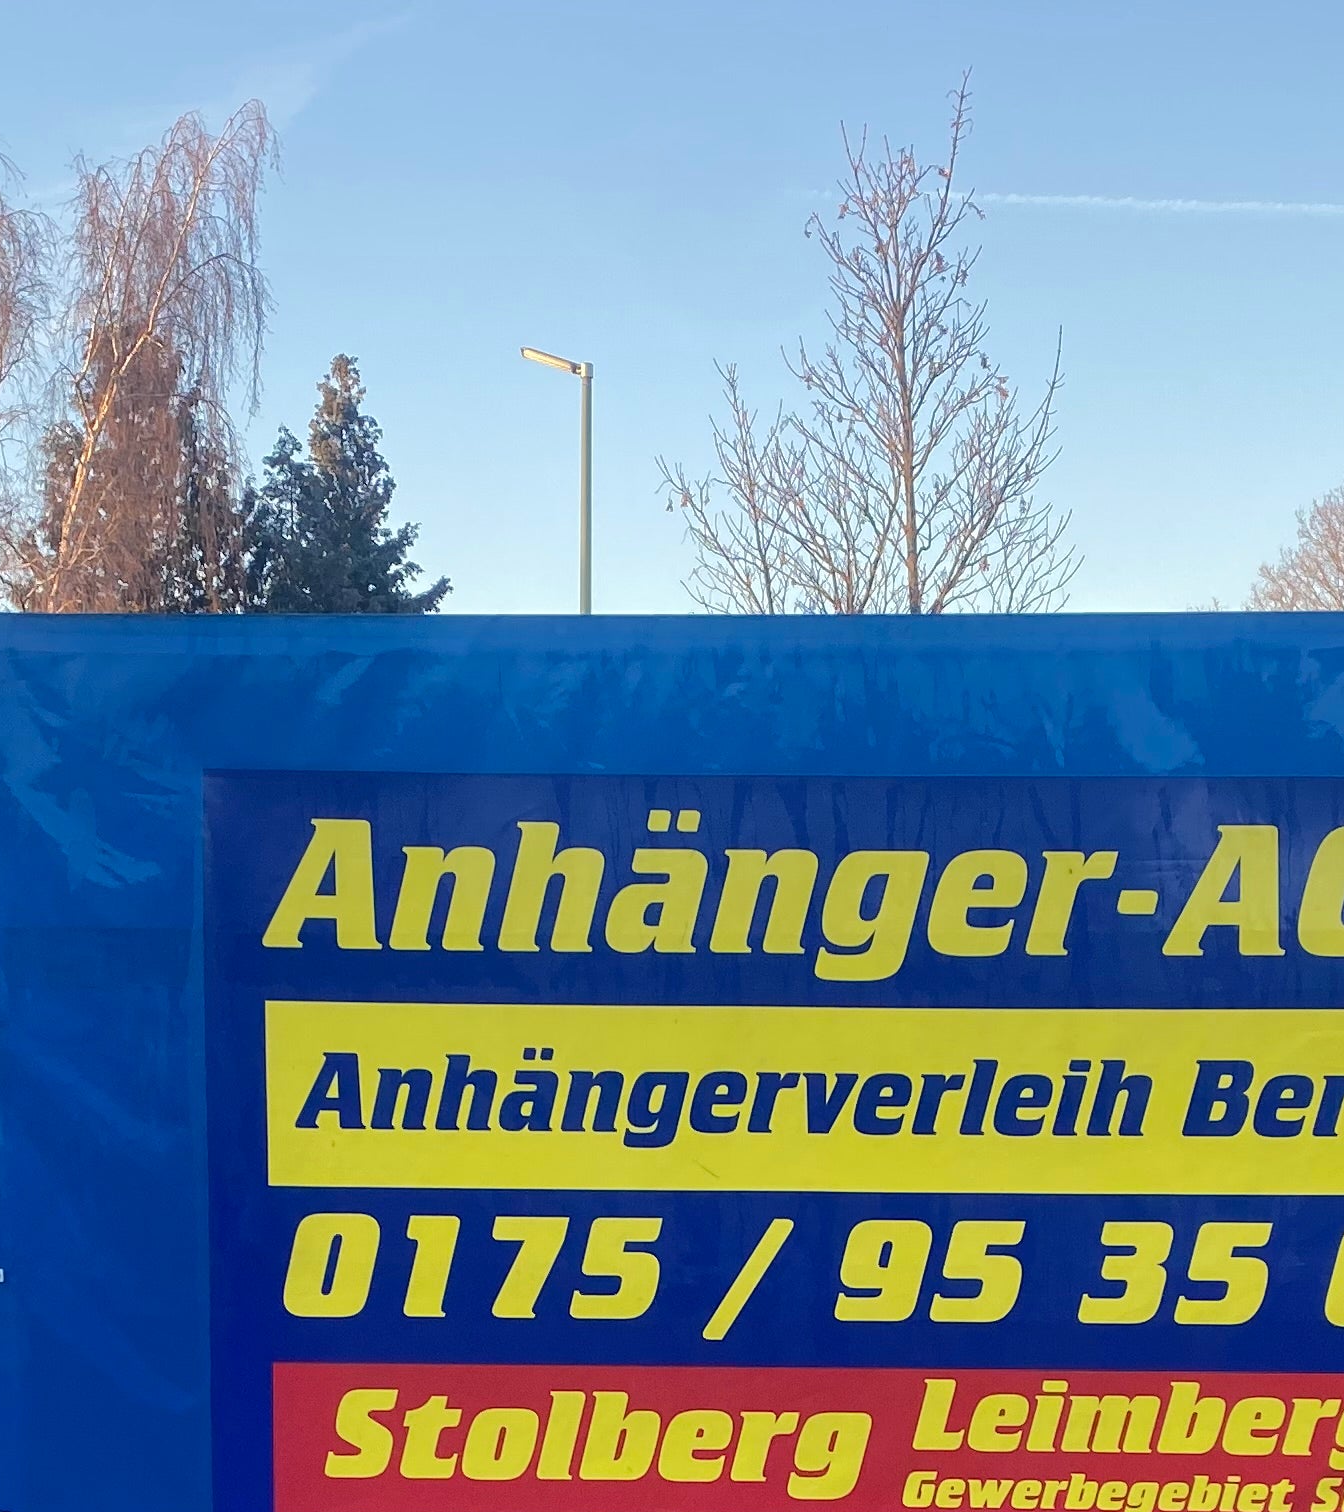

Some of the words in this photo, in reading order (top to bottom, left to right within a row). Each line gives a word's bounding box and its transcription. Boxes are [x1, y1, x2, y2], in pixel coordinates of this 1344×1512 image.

[295, 1047, 1153, 1148] Anhängerverleih
[284, 1213, 663, 1320] 0175
[703, 1218, 794, 1341] /
[835, 1220, 1025, 1323] 95
[1077, 1222, 1272, 1326] 35
[325, 1388, 873, 1501] Stolberg
